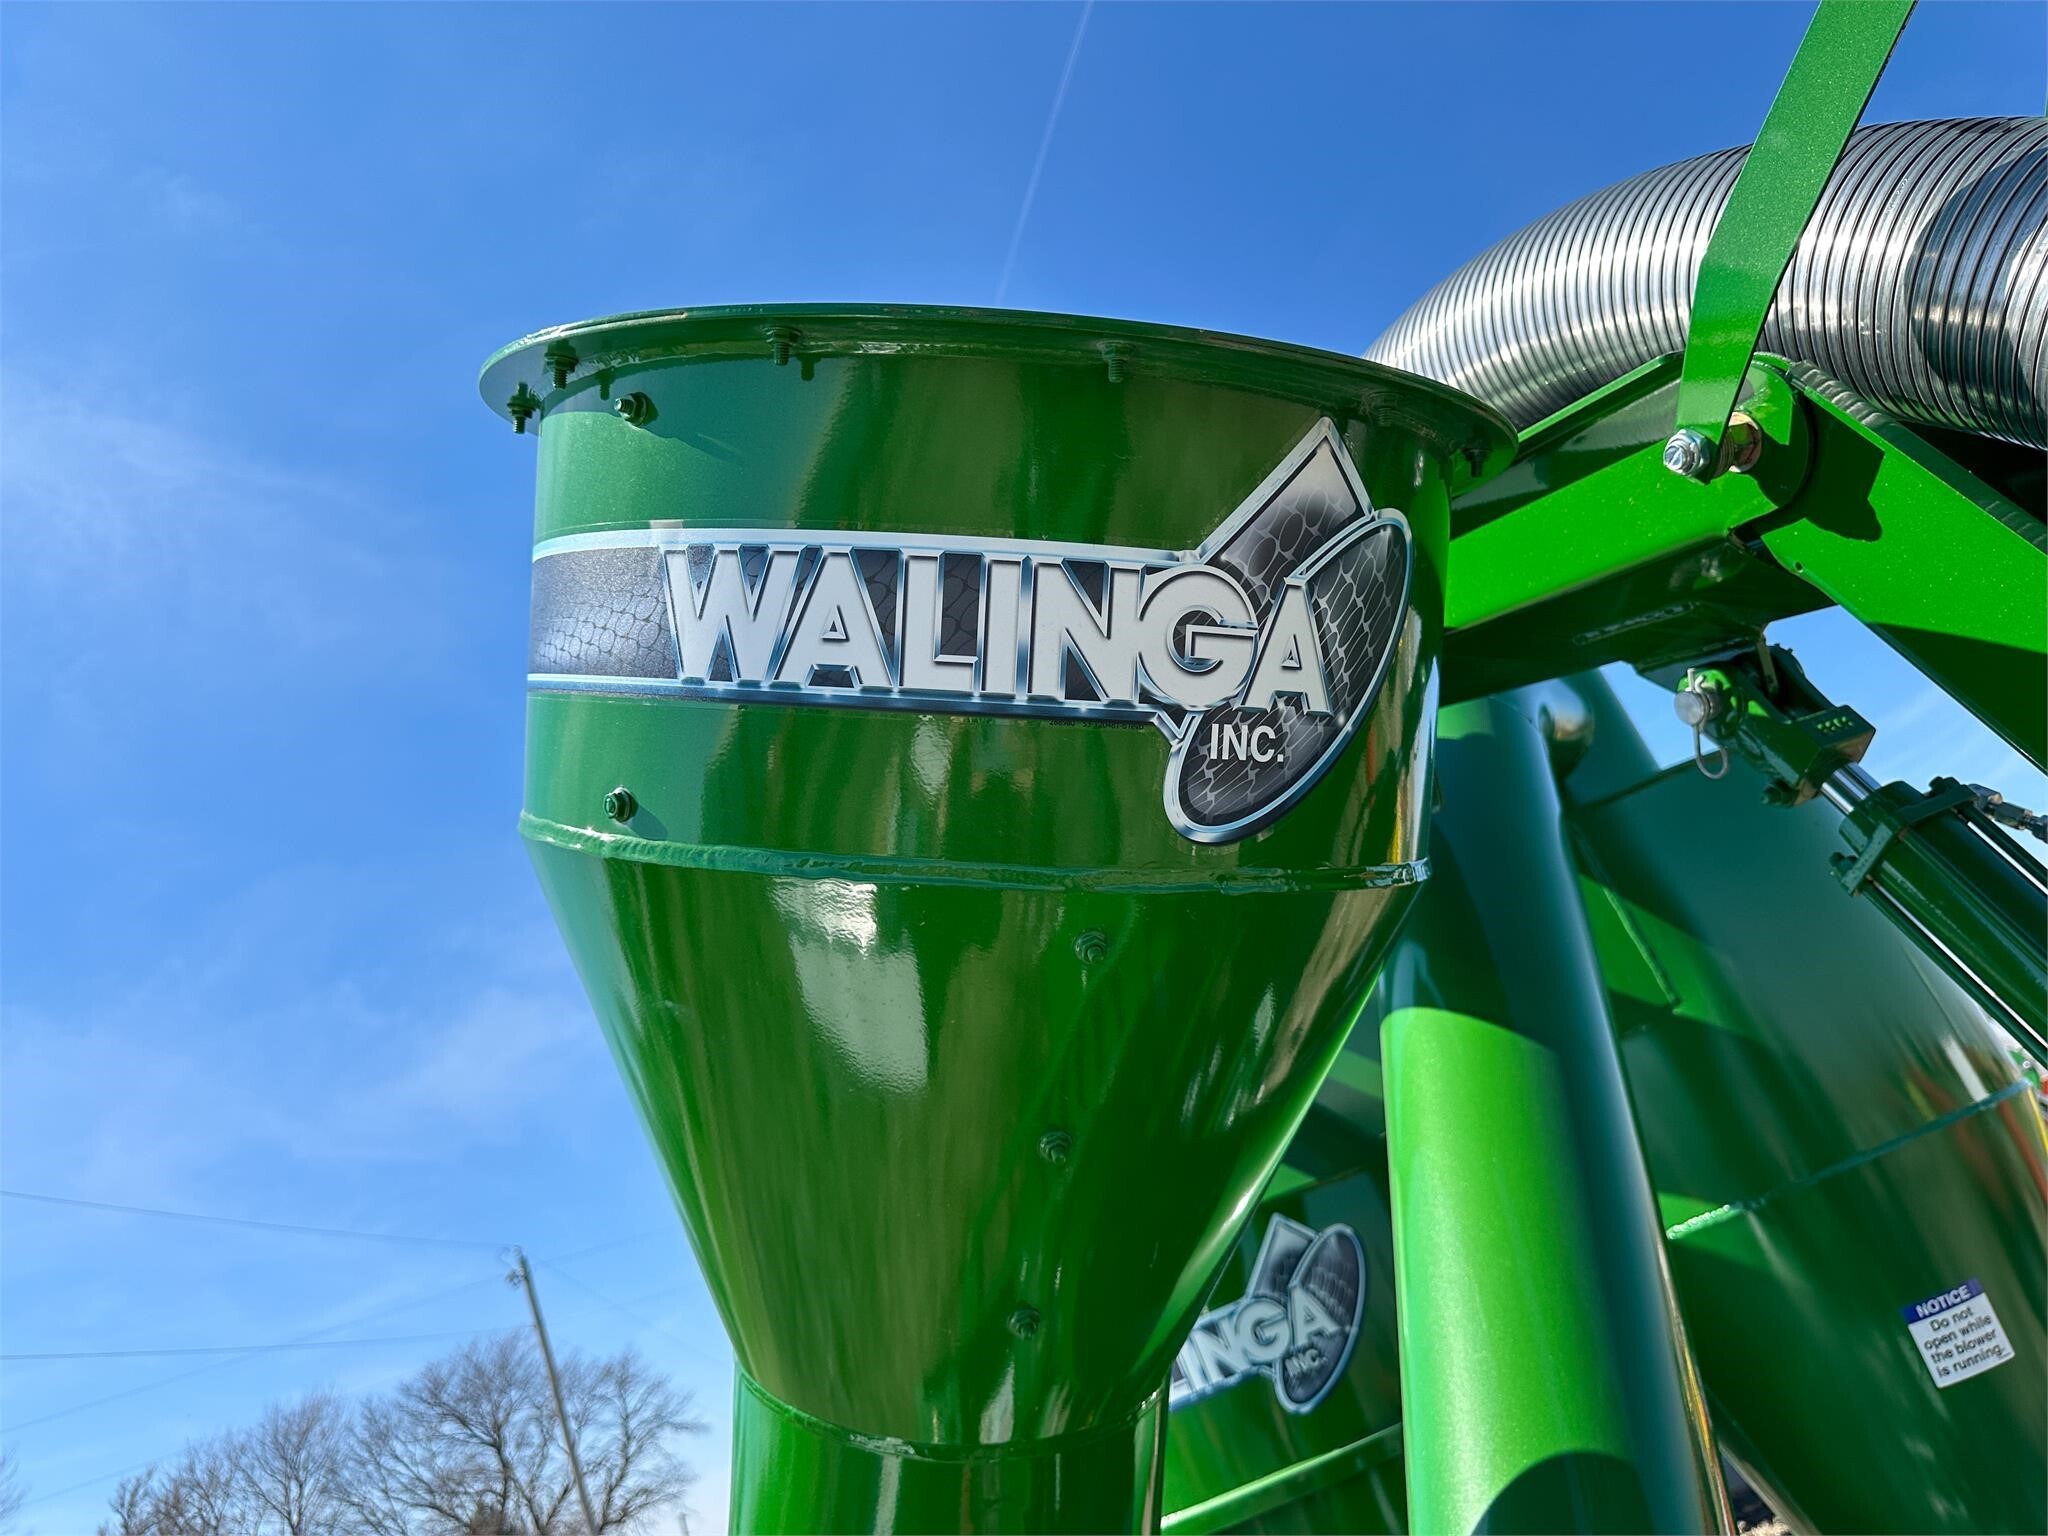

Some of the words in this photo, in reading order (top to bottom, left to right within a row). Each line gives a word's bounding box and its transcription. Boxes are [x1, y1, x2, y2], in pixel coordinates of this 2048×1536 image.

[661, 544, 1334, 716] WALINGA
[1210, 723, 1284, 764] INC.
[1915, 1285, 1972, 1318] NOTICE
[1930, 1318, 1949, 1331] Do
[1952, 1307, 1974, 1322] not
[1924, 1331, 1957, 1350] open
[1959, 1315, 1992, 1336] while
[1931, 1349, 1953, 1364] the
[1955, 1329, 1997, 1354] blower
[1936, 1366, 1950, 1378] is
[1953, 1345, 2002, 1371] running
